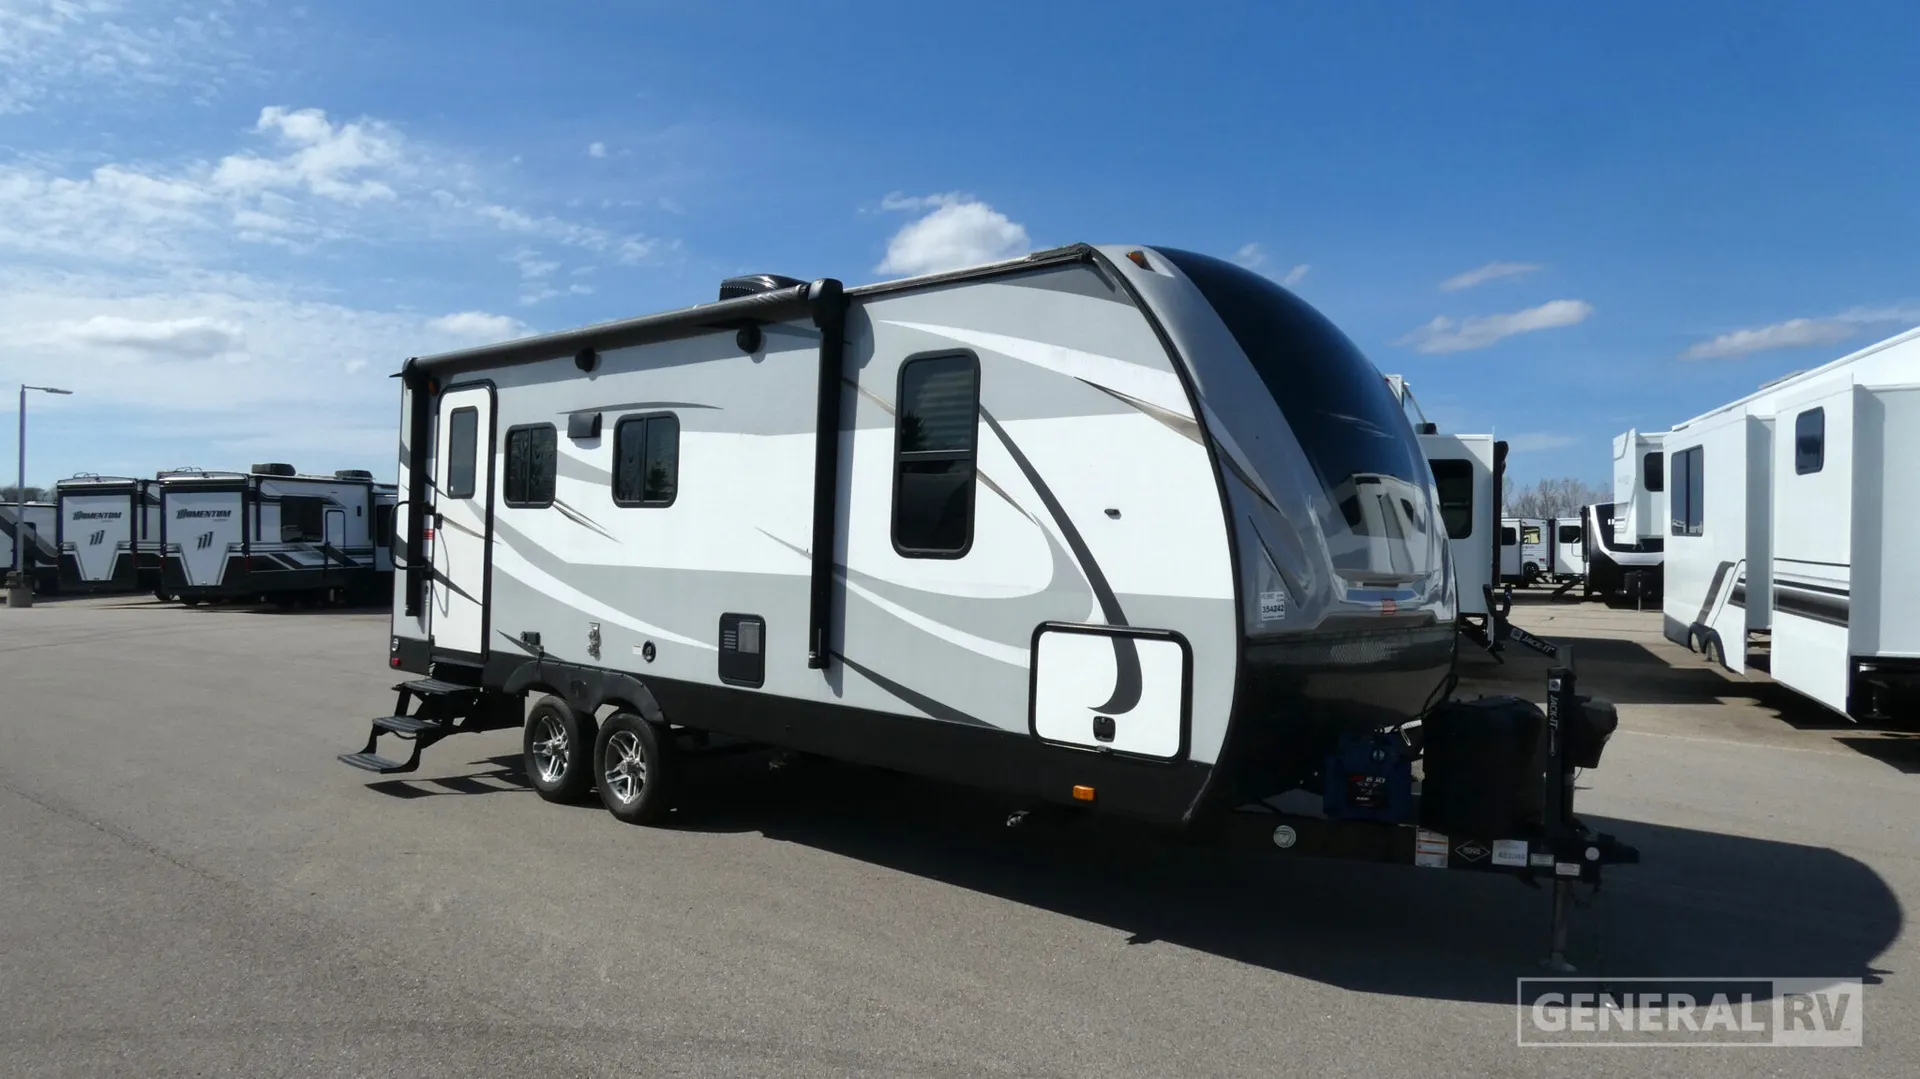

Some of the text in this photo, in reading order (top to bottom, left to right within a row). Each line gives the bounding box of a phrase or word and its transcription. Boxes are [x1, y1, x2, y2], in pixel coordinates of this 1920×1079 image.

[72, 510, 122, 520] MOMENTUM
[176, 508, 231, 519] MOMENTUM
[1262, 604, 1284, 613] 354242
